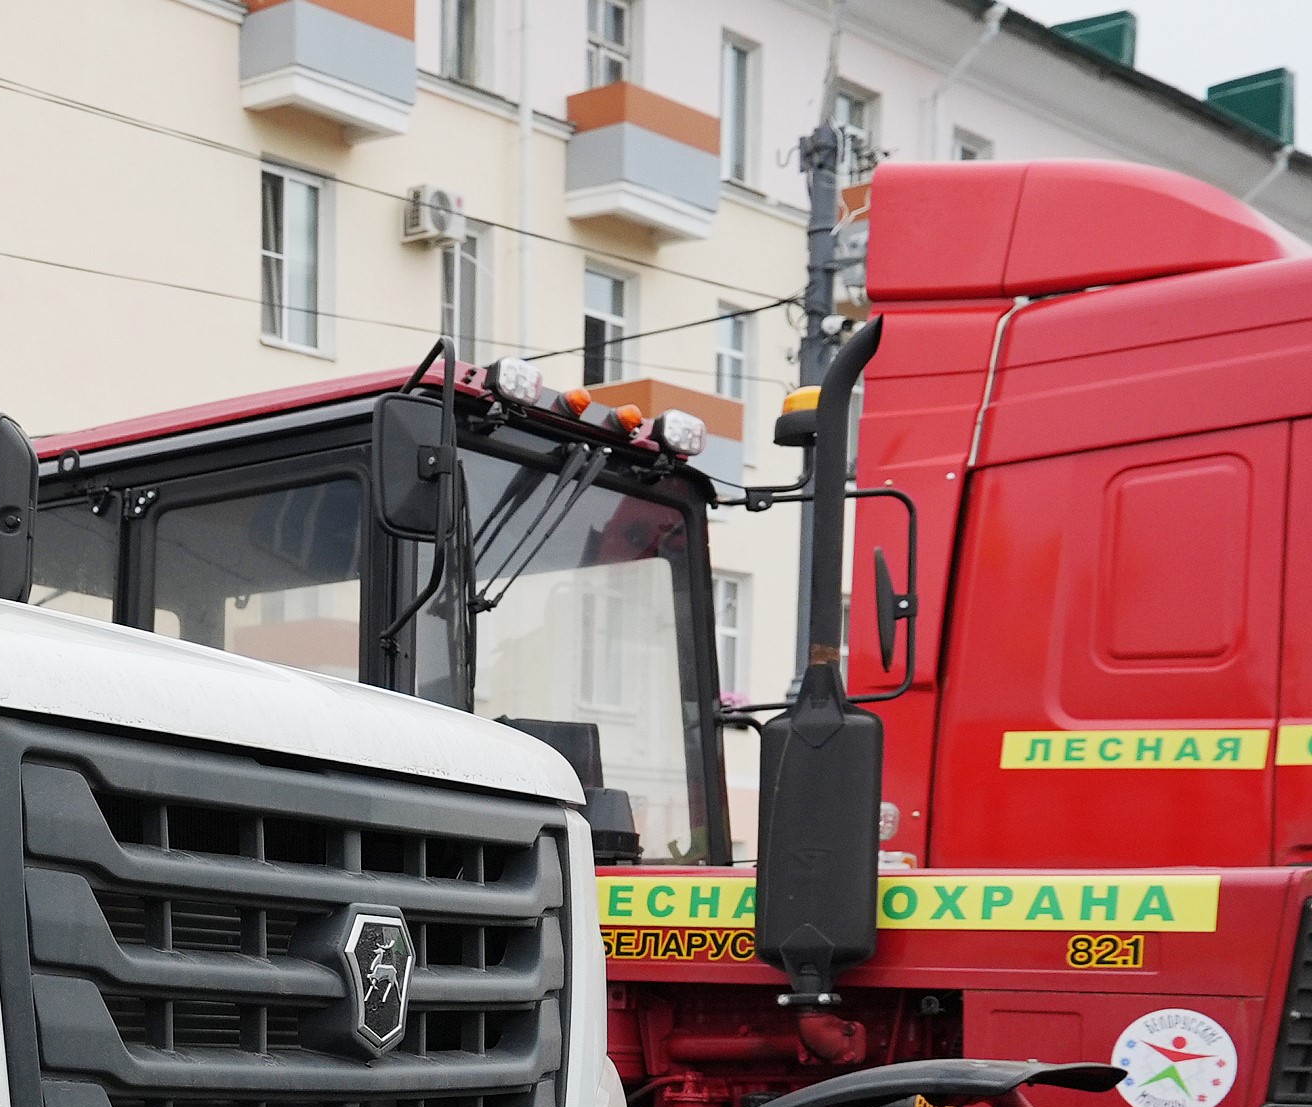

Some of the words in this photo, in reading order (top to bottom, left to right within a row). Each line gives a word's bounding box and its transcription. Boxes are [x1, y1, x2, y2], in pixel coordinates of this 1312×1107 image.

[1025, 737, 1243, 762] ЛЕСНАЯ
[607, 885, 755, 919] ЕСНА
[881, 885, 1175, 921] ОХРАНА
[1067, 935, 1145, 969] 82.1
